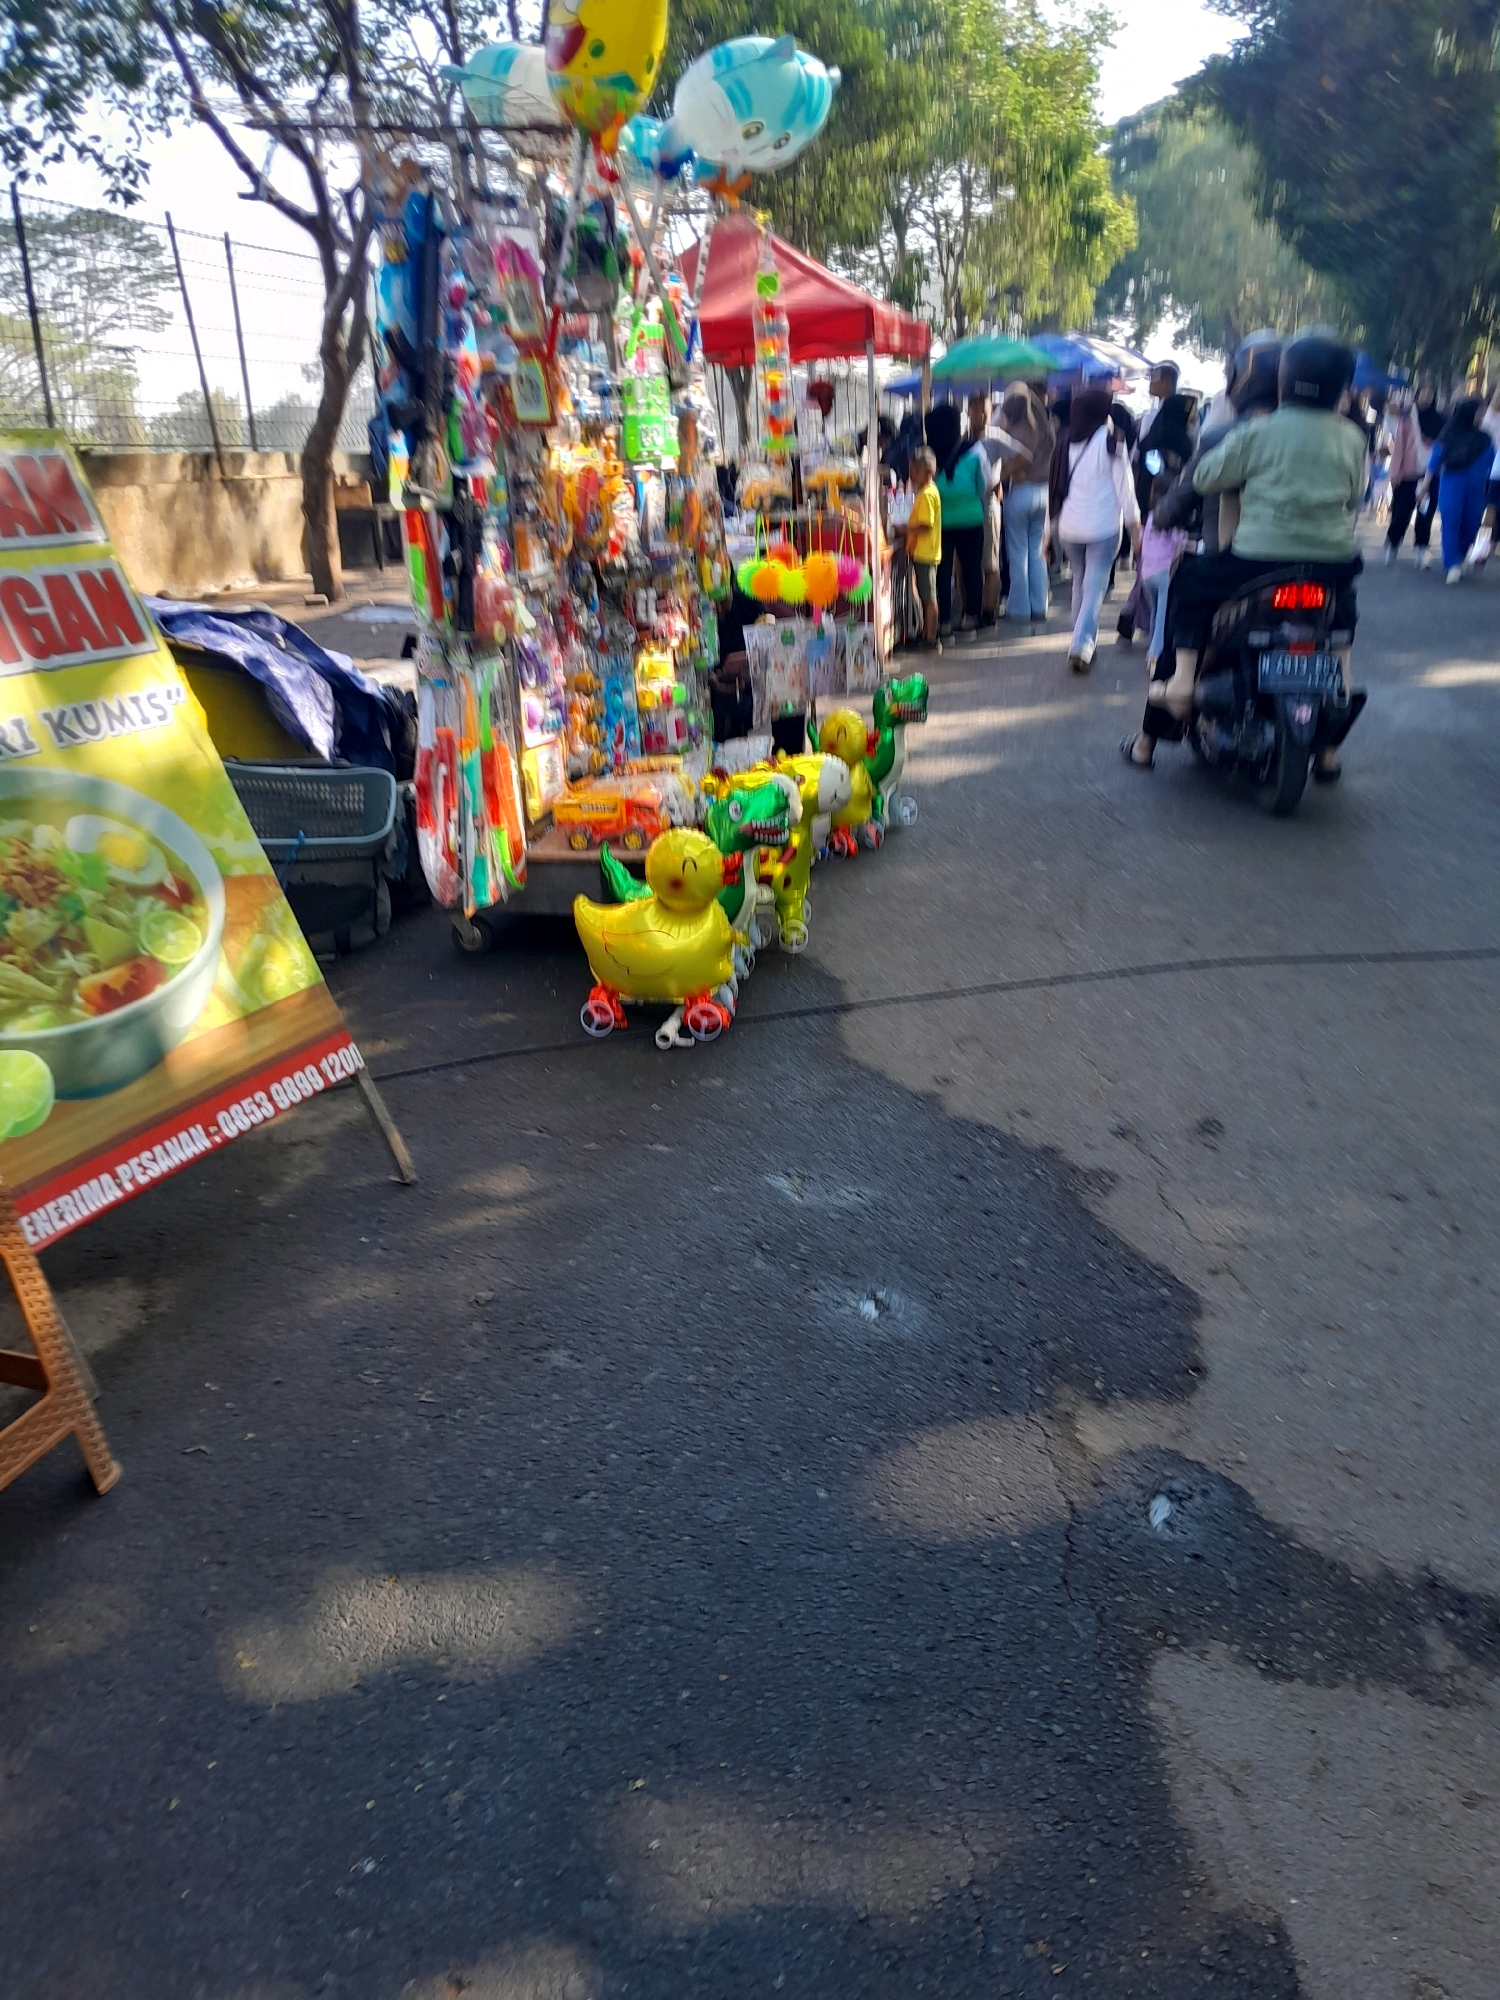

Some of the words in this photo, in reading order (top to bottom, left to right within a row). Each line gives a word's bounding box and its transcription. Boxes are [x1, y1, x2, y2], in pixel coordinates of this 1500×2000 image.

[114, 1123, 213, 1192] PESANAN
[216, 1091, 276, 1139] 0853
[270, 1063, 326, 1110] 9899
